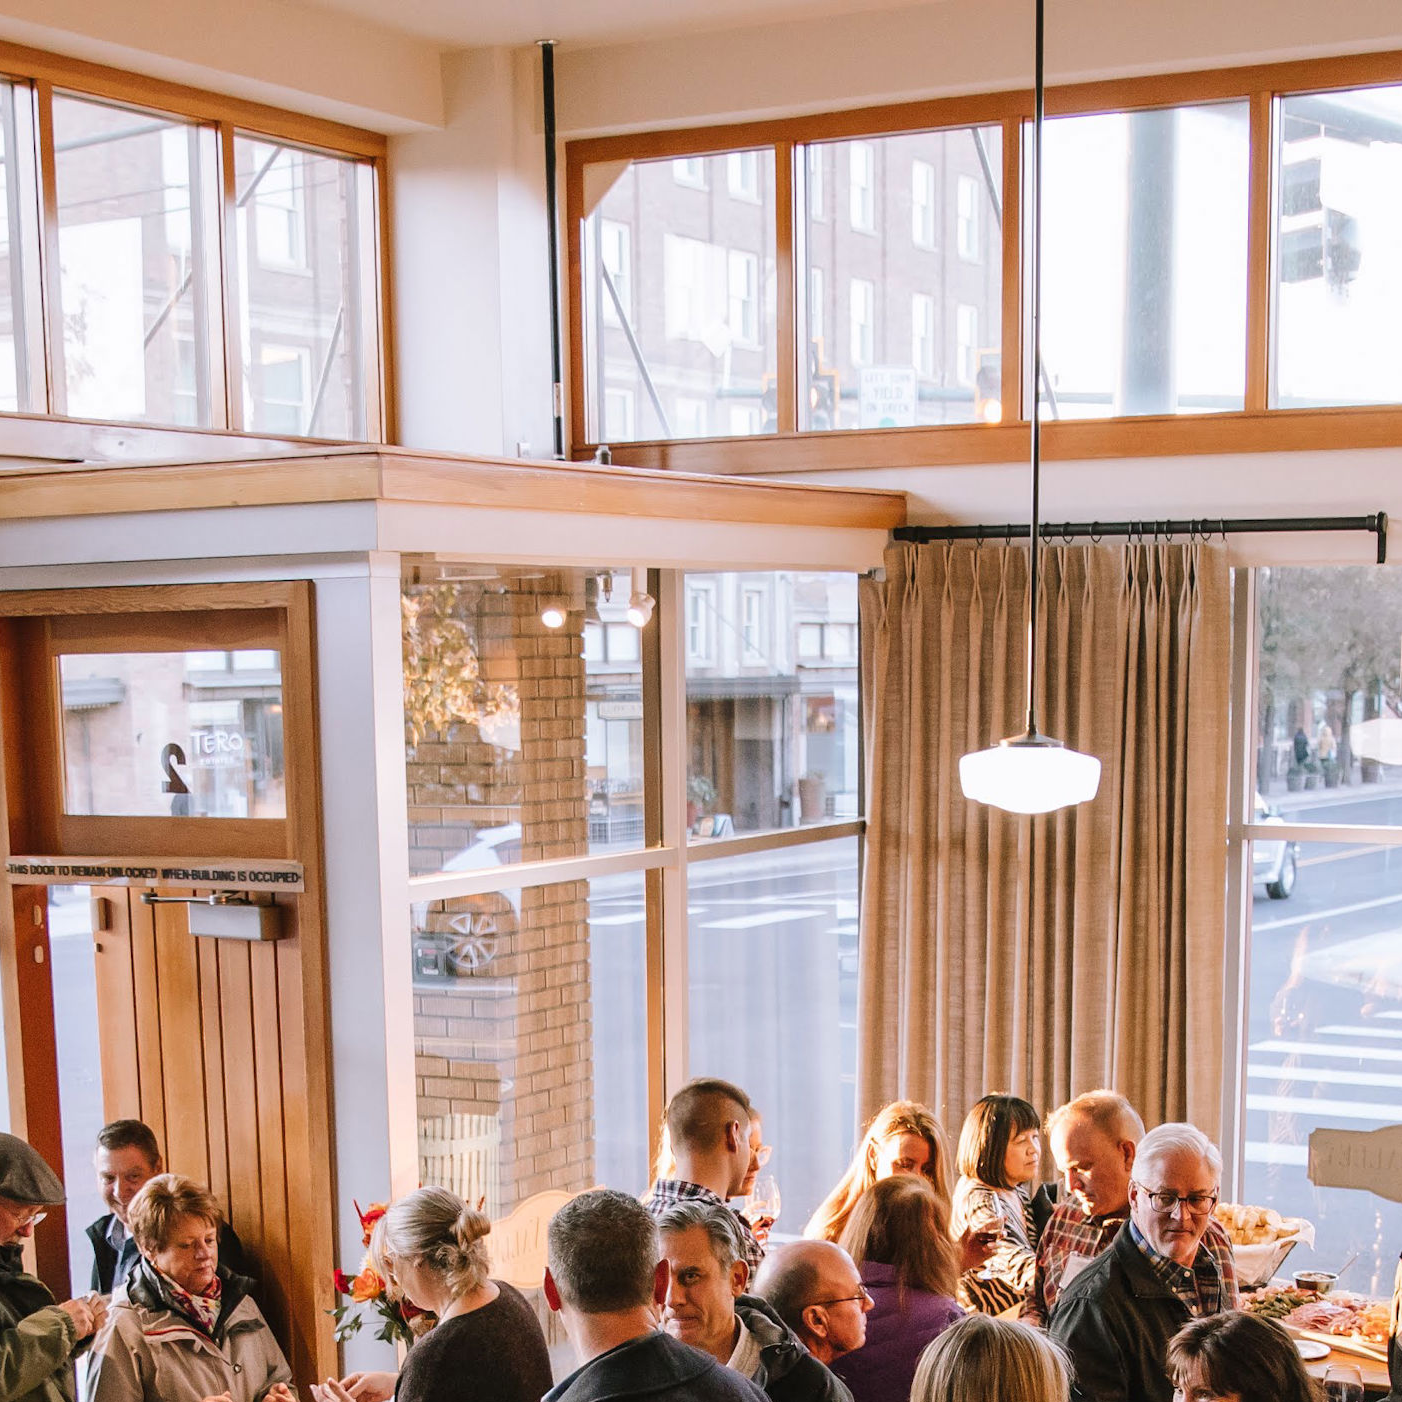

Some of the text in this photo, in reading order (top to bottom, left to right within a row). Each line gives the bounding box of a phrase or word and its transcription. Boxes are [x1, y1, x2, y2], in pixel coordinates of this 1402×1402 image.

[873, 386, 903, 400] YIELD
[30, 864, 55, 875] DOOR
[57, 865, 70, 876] TO
[237, 870, 247, 882] IS
